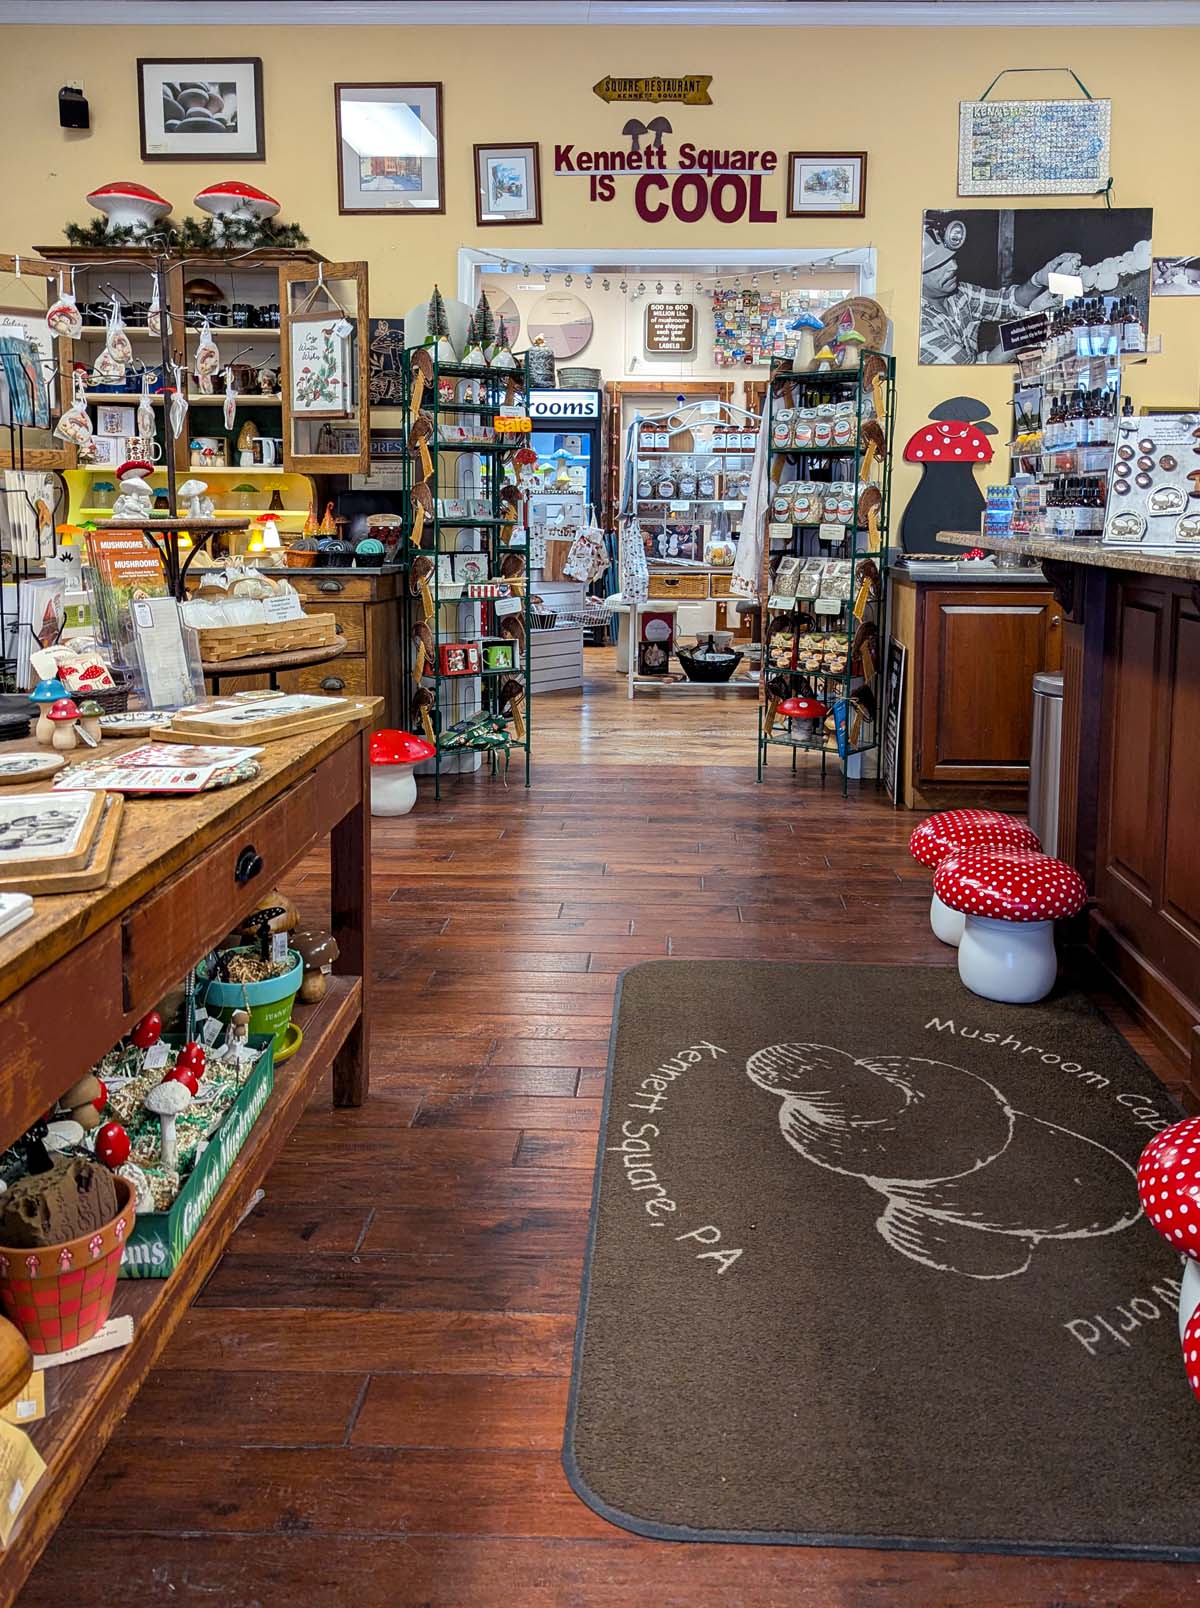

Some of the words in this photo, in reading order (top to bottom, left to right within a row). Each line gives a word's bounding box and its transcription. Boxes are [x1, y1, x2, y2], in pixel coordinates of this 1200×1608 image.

[605, 80, 639, 92] SQUARE
[644, 80, 701, 92] RESTAURANT
[554, 143, 667, 172] Kennett
[678, 143, 778, 178] Square
[590, 174, 616, 202] IS
[635, 173, 778, 224] COOL
[301, 352, 321, 361] Wishes
[494, 416, 532, 433] sale
[100, 541, 144, 549] MUSHROOMS
[114, 559, 160, 569] MUSHROOMS
[924, 1017, 1110, 1089] Mushroom
[627, 1040, 729, 1114] Kennett
[183, 1162, 221, 1237] Garden
[219, 1076, 268, 1170] Mushrooms
